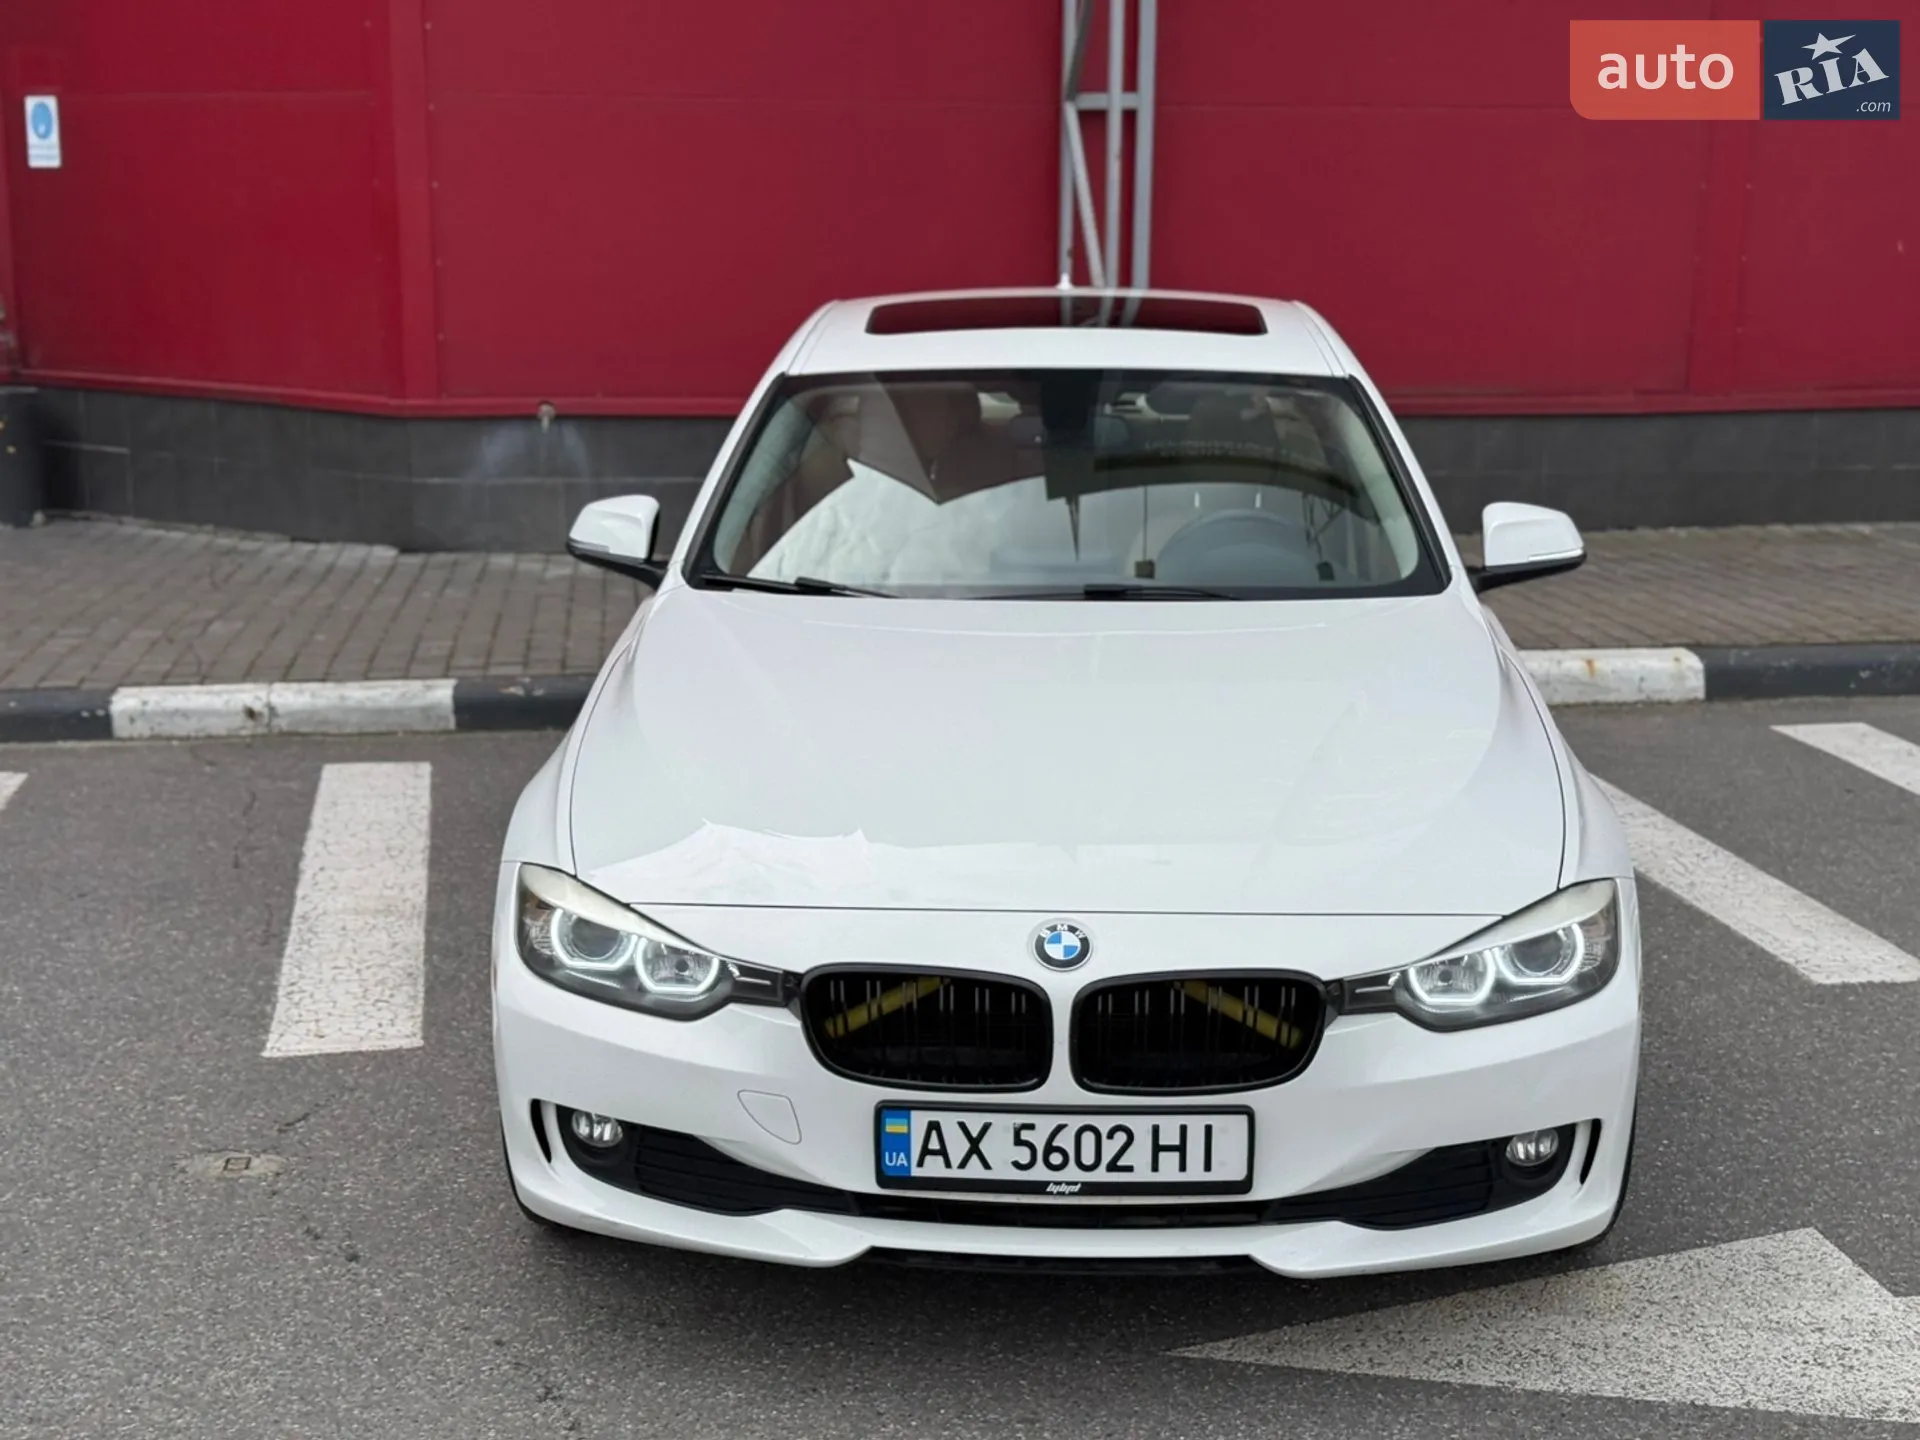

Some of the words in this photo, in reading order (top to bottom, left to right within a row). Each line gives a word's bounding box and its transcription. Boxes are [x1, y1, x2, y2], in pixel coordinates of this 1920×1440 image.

[1039, 923, 1087, 939] BMW
[916, 1120, 993, 1171] AX
[1010, 1122, 1135, 1173] 5602
[1151, 1123, 1213, 1173] HI
[885, 1152, 909, 1168] UA
